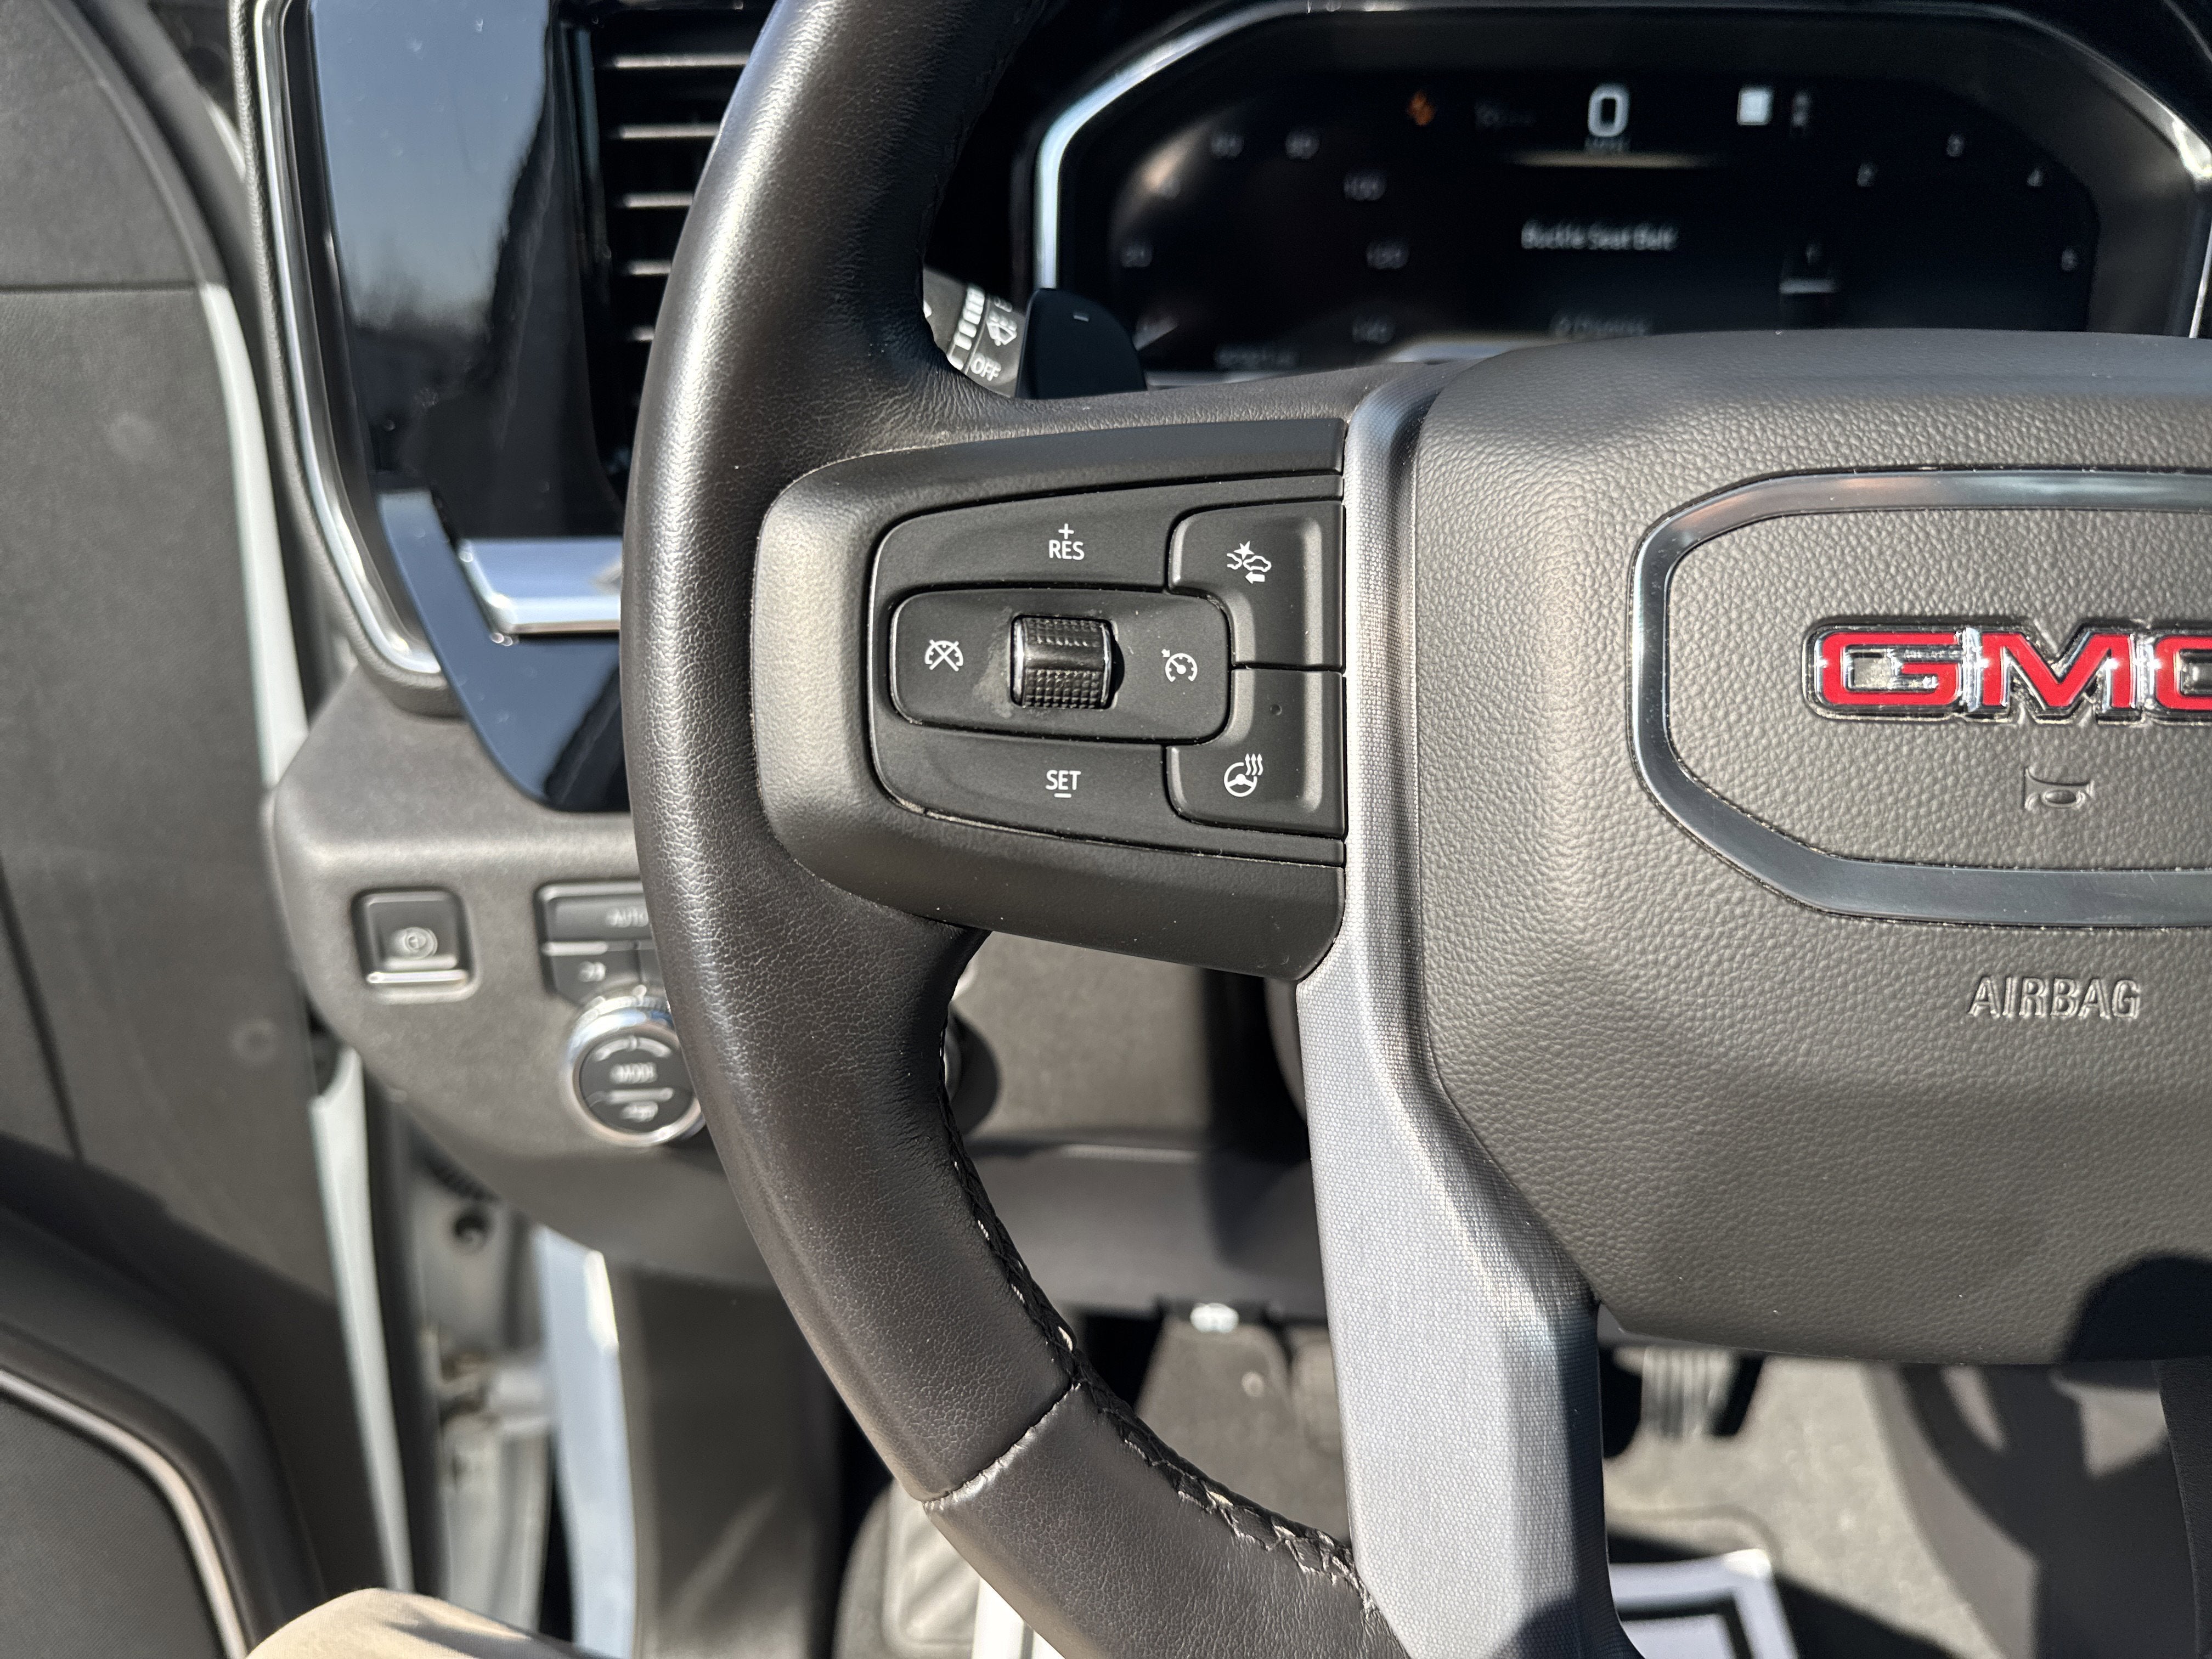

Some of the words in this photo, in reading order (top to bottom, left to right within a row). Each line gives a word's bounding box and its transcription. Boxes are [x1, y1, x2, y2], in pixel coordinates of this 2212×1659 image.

[1587, 82, 1630, 137] 0
[970, 352, 1002, 381] OFF
[1048, 540, 1085, 561] RES
[1045, 770, 1081, 791] SET
[1968, 975, 2141, 1018] AIRBAG
